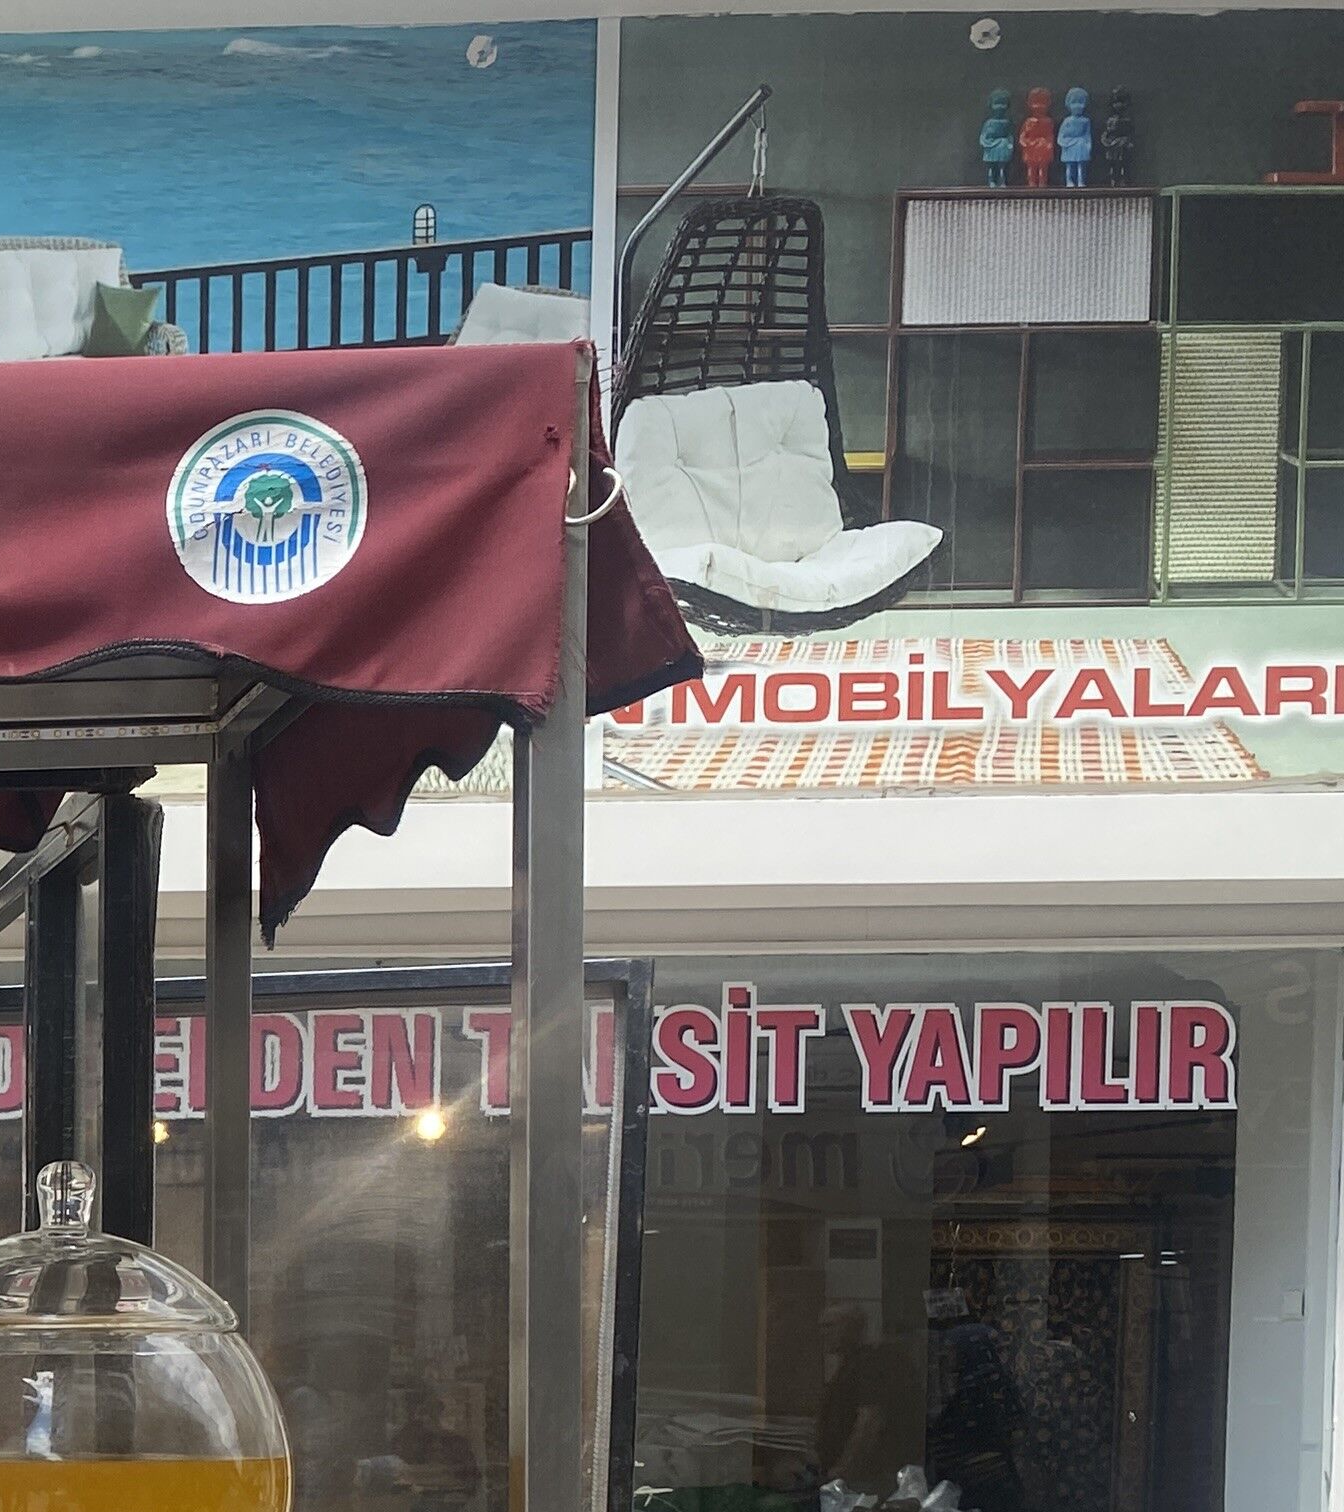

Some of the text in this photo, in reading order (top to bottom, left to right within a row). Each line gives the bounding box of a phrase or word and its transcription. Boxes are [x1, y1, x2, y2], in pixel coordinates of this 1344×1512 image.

[189, 431, 348, 543] ODUNPAZARI BELEDİYESİ
[467, 982, 824, 1116] TSİT
[842, 1000, 1237, 1113] YAPILIR
